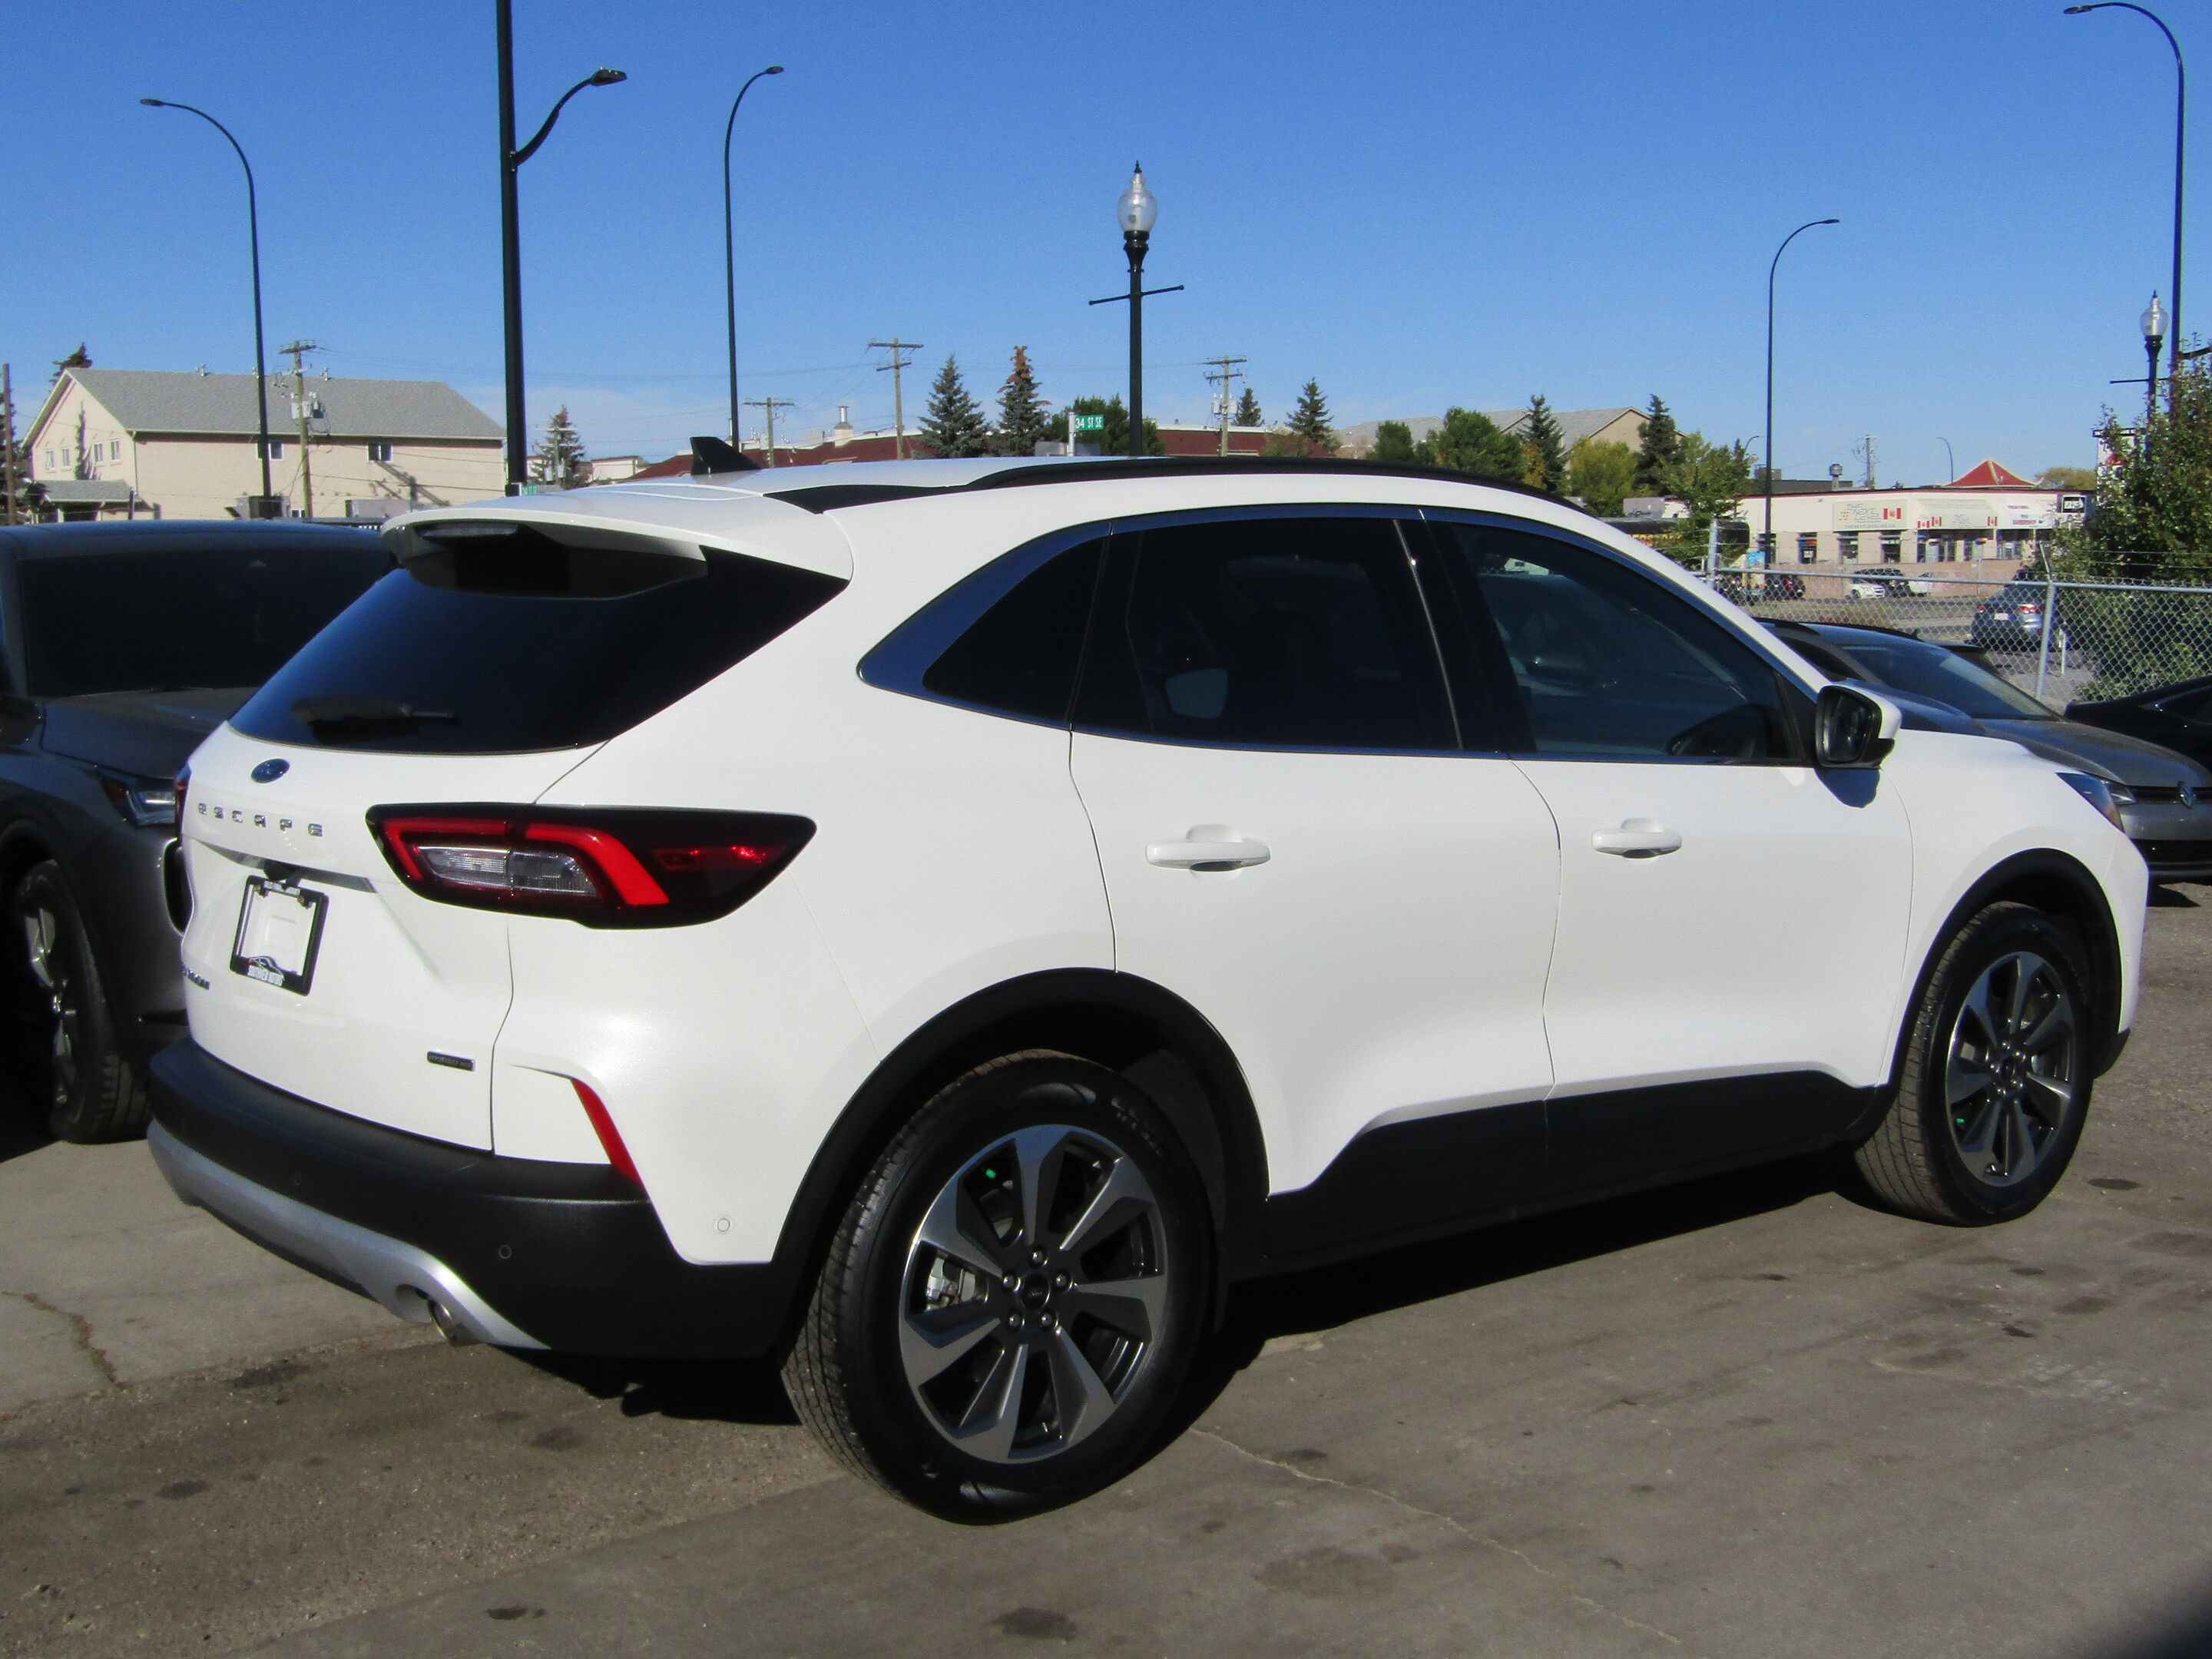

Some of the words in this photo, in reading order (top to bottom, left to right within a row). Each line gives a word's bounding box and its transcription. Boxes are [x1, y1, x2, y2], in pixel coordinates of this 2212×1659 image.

[1088, 416, 1094, 428] ST
[1095, 416, 1102, 428] SE
[198, 803, 323, 837] ESCAPE
